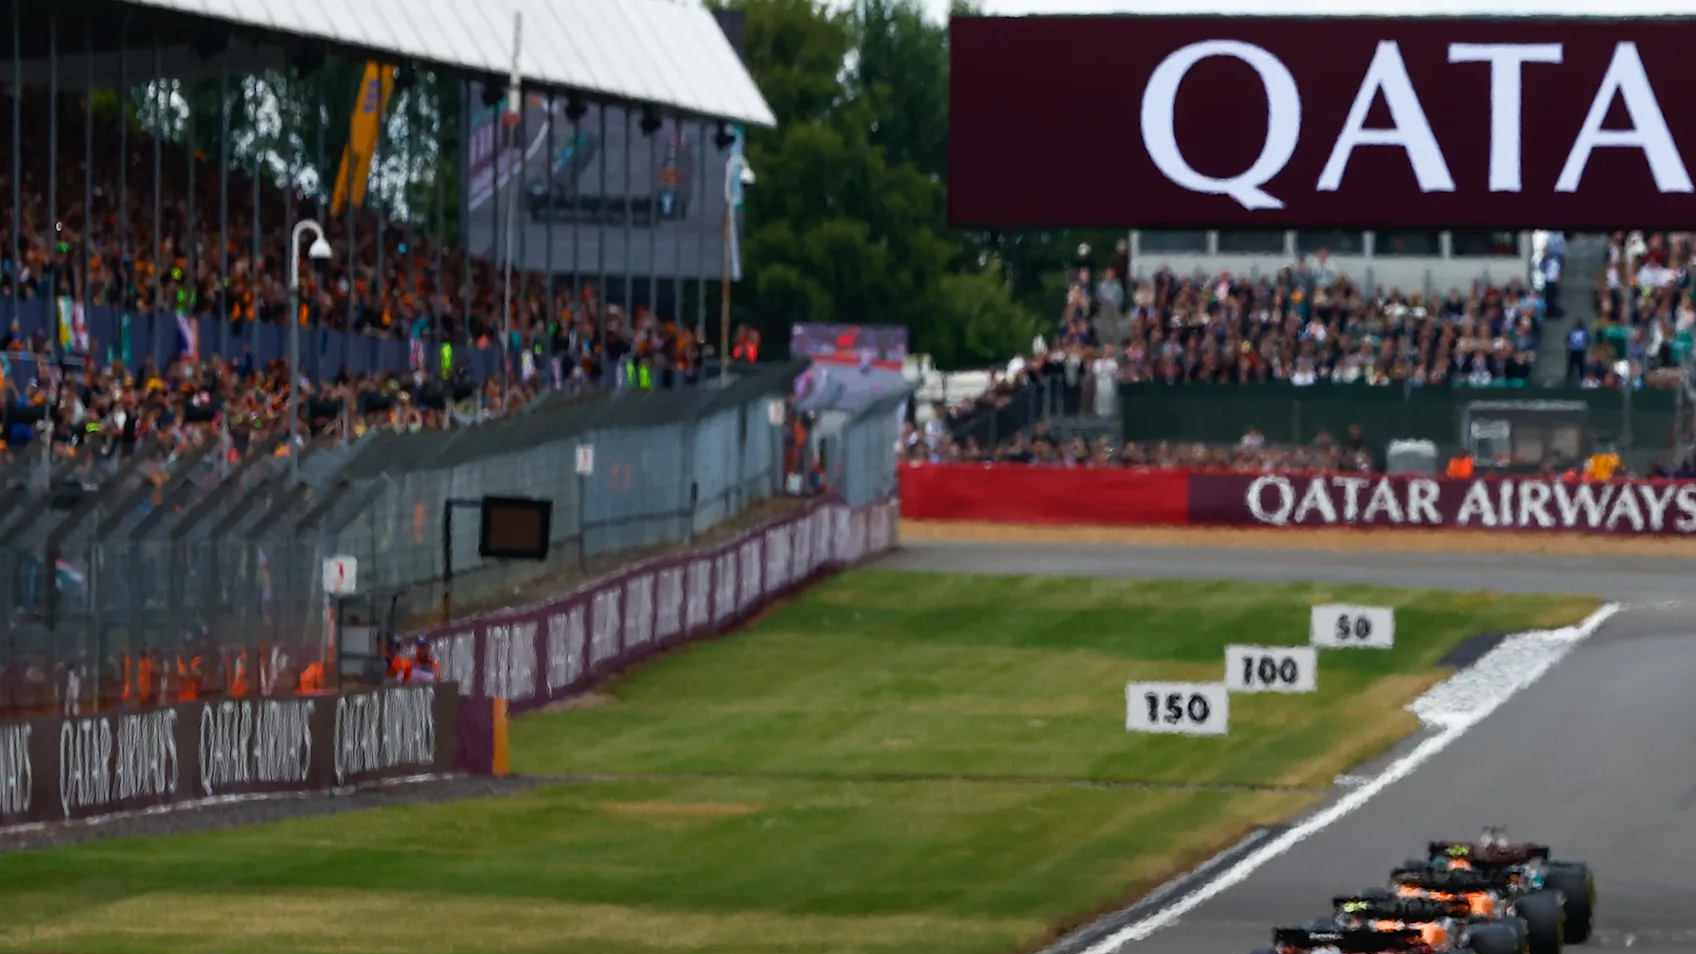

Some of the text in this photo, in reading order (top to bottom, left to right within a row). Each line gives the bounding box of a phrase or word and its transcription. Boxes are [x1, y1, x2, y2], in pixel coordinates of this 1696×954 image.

[1246, 474, 1443, 527] QATAR
[1335, 614, 1372, 640] 50
[1242, 656, 1298, 685] 100
[1144, 692, 1211, 724] 150
